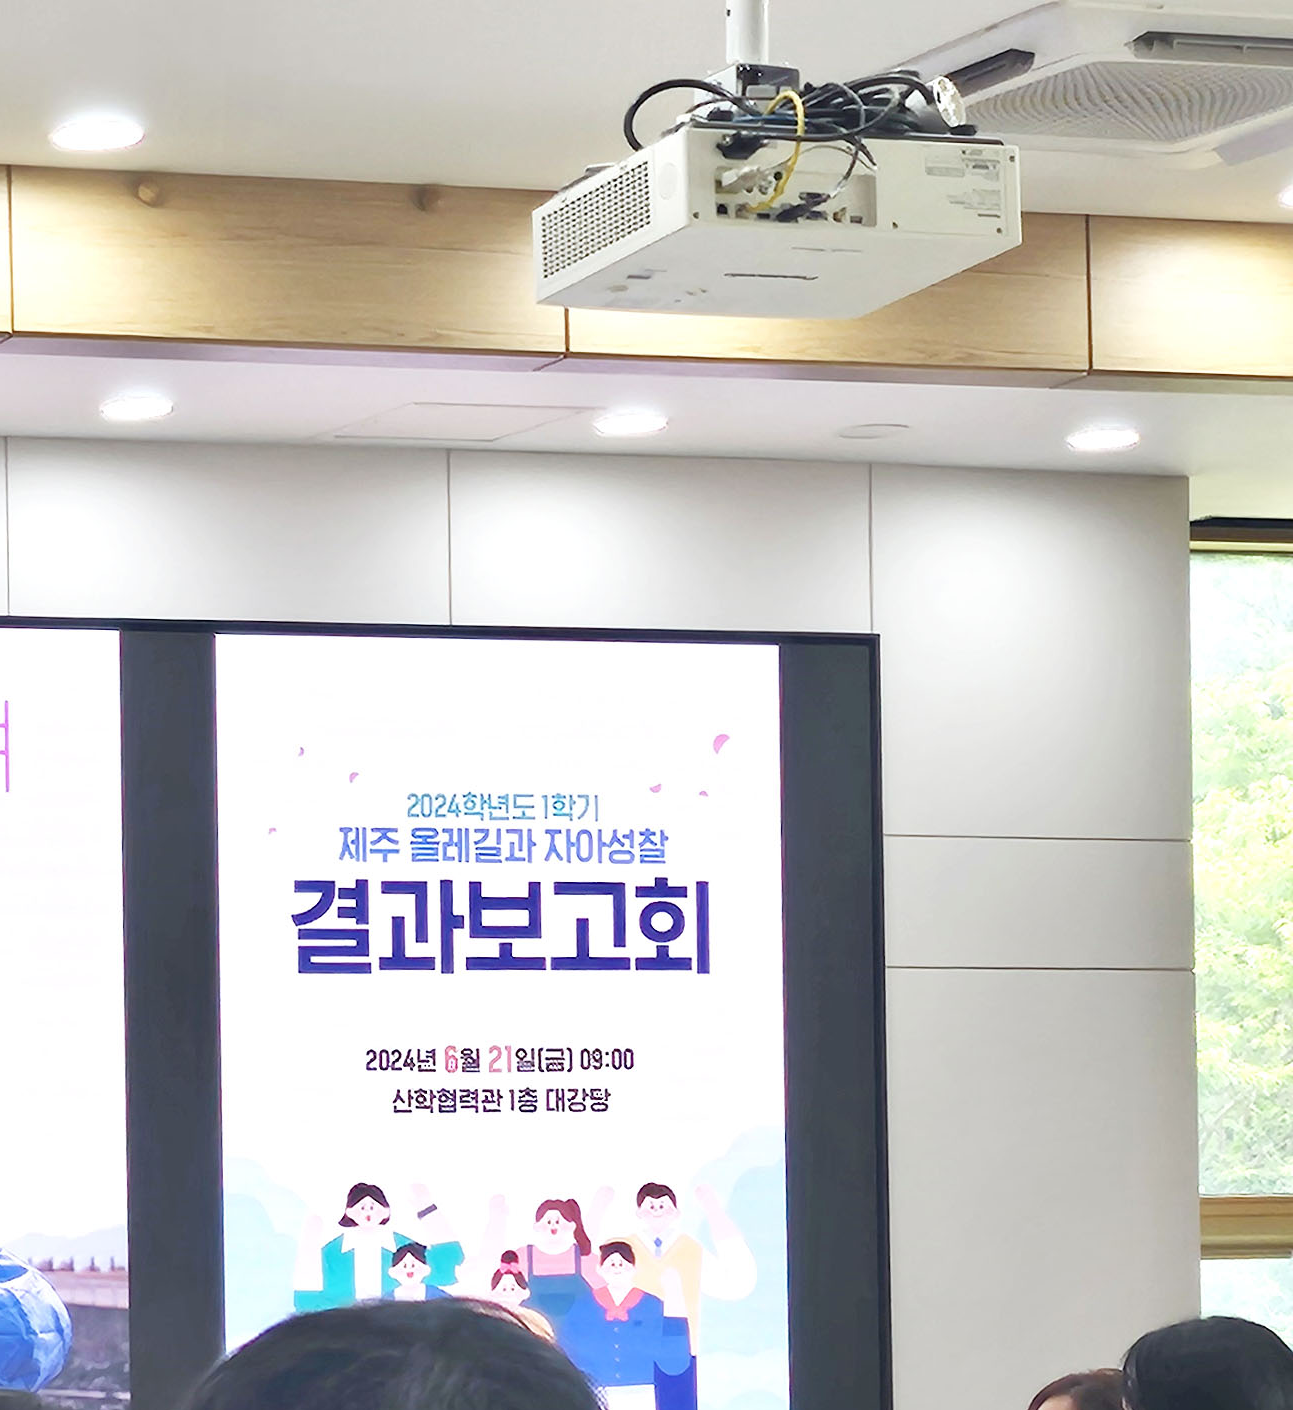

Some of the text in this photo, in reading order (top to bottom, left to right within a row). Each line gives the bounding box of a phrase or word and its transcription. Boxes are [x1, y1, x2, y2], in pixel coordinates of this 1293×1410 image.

[406, 791, 599, 823] 2024학년도 1학기
[338, 826, 670, 865] 제주 올레길과 자아성찰
[290, 876, 711, 975] 결과보고회
[365, 1044, 635, 1074] 2024년 6월 21일(금) 09:00
[391, 1086, 612, 1114] 산학협력관 1층 대강당
